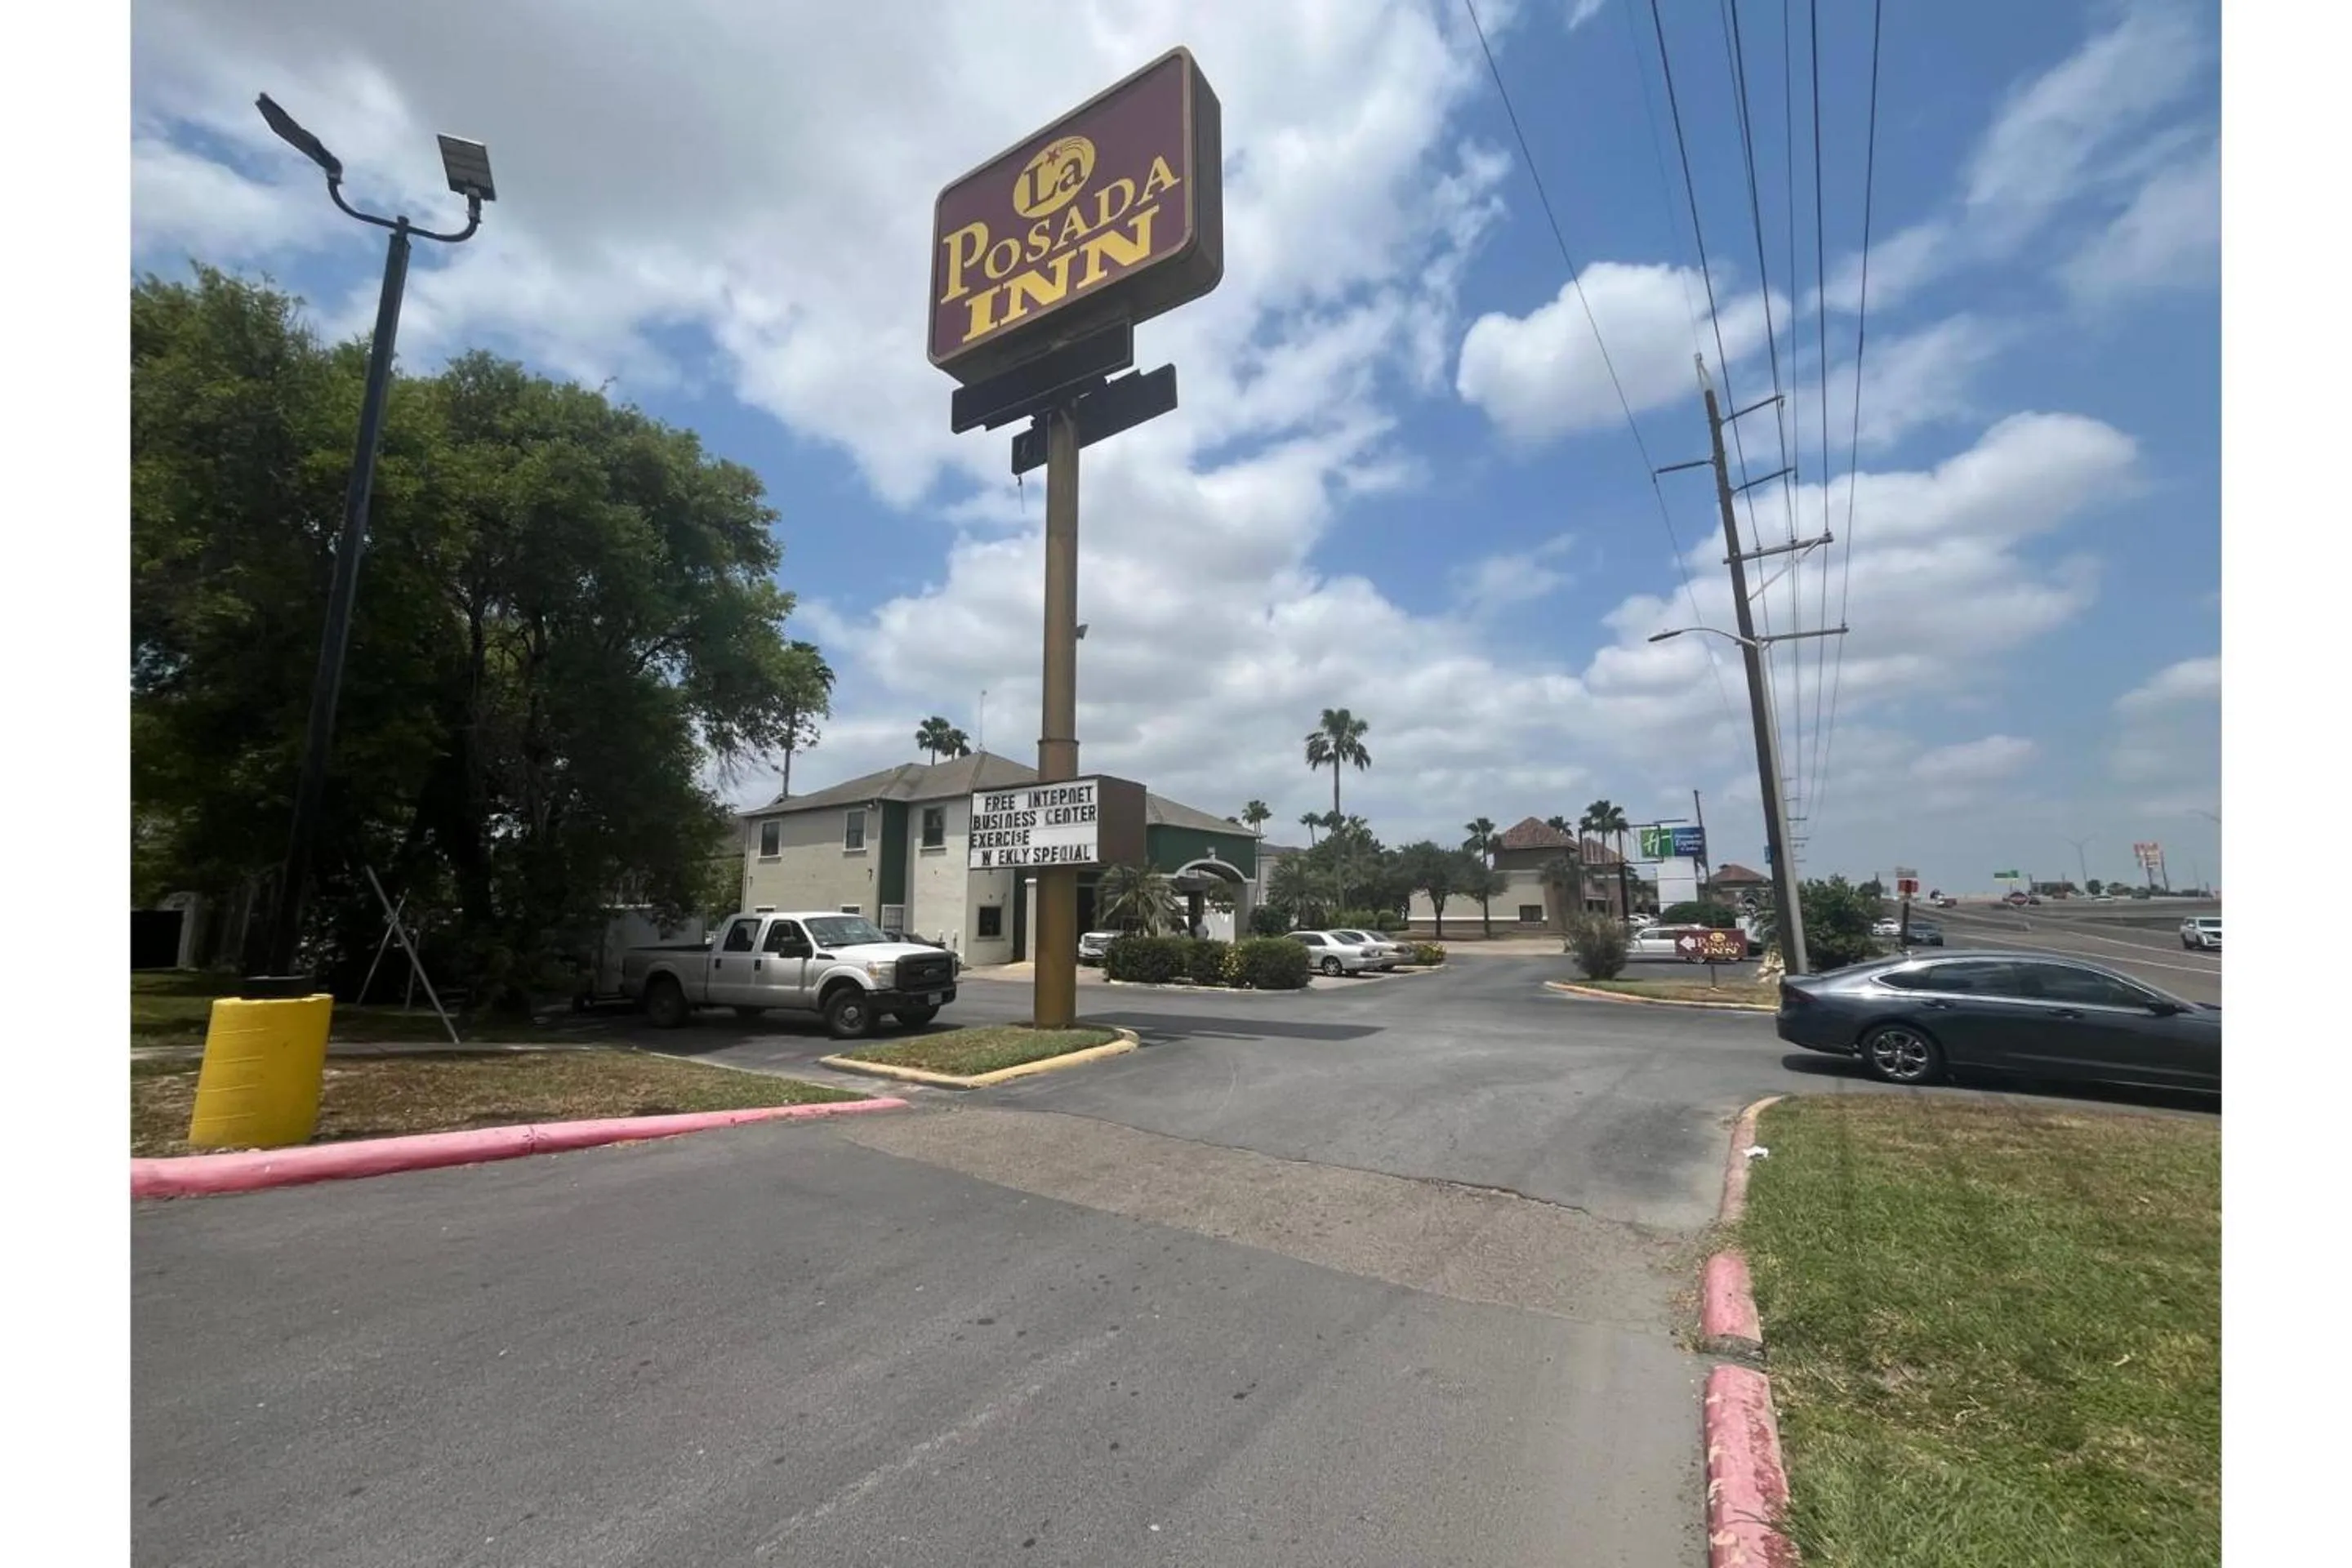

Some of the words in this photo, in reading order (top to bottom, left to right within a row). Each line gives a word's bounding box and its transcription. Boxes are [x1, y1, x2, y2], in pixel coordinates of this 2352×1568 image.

[1023, 157, 1085, 214] La
[941, 154, 1181, 304] POSADA
[962, 204, 1160, 343] INN
[973, 811, 1036, 831] BUSINESS
[1045, 805, 1096, 825] CENTER
[985, 795, 1015, 813] FREE
